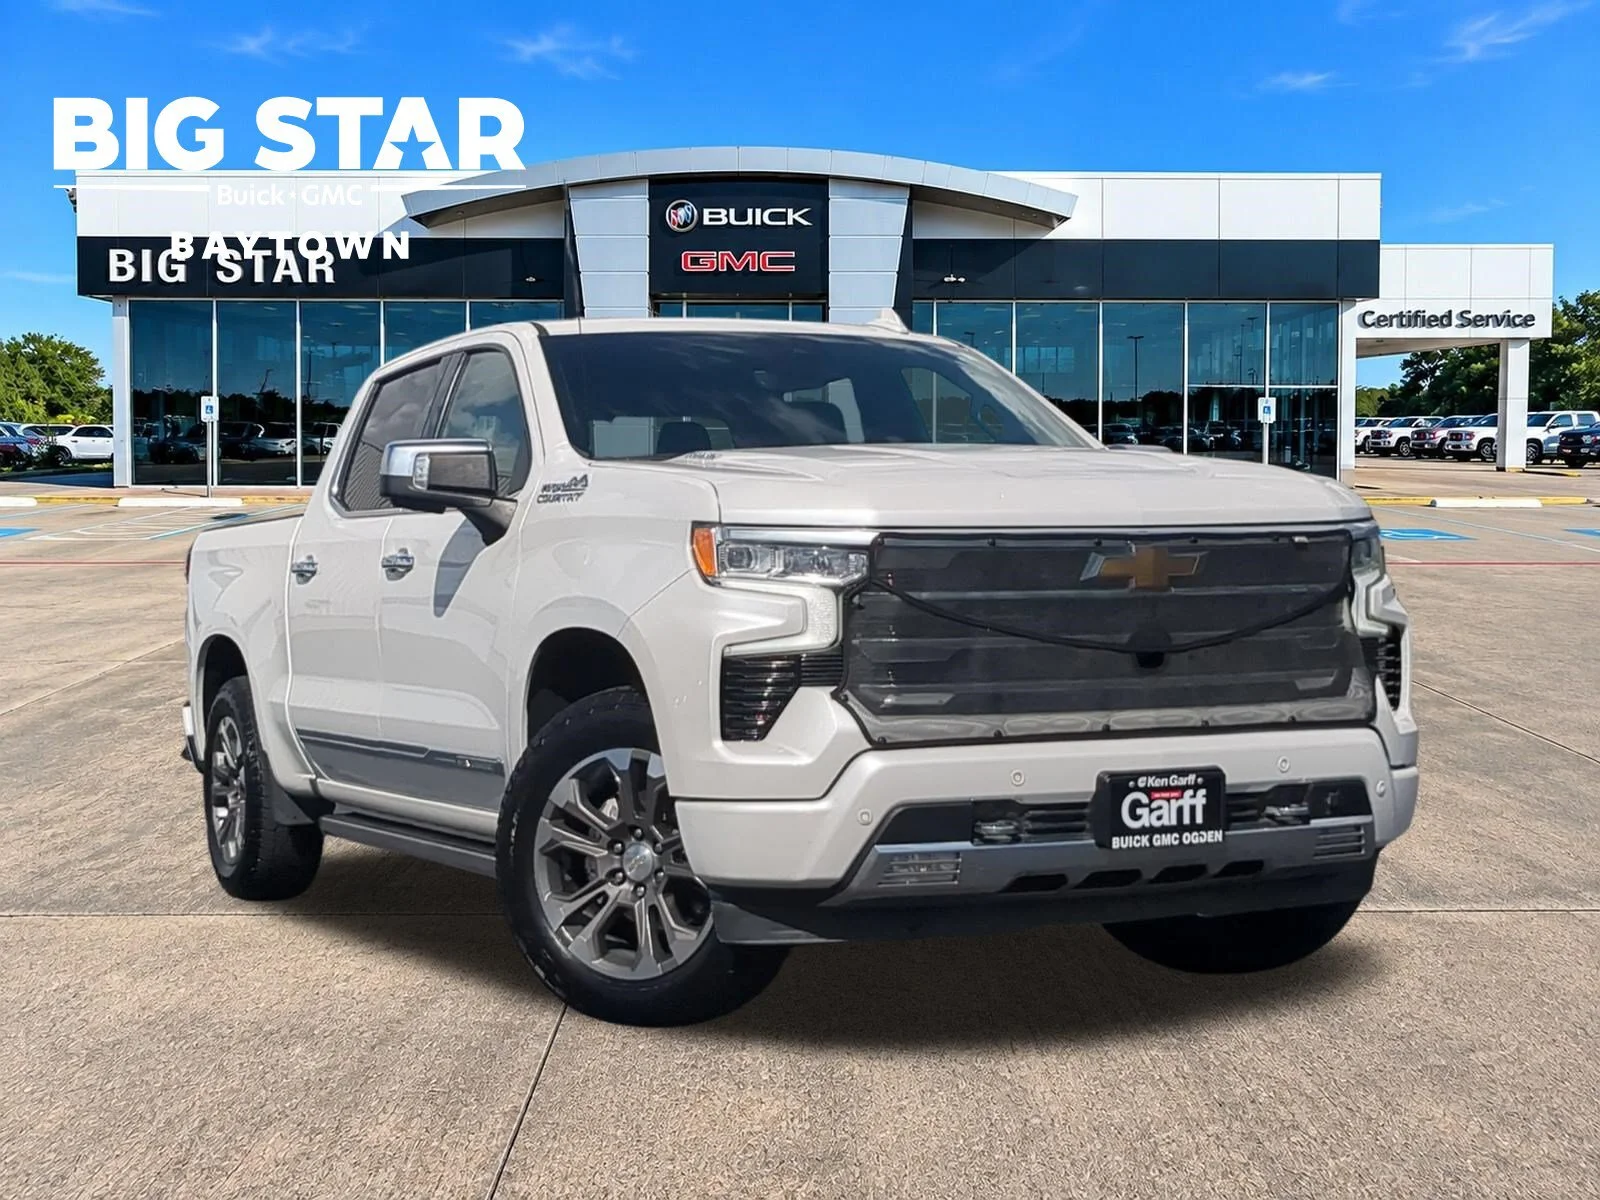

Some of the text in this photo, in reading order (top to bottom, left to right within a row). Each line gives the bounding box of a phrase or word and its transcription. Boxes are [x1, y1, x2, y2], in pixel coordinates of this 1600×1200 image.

[702, 207, 813, 226] BUICK
[108, 248, 336, 284] BIG STAR
[681, 250, 795, 272] GMC
[1360, 309, 1536, 328] Certified Service
[1147, 773, 1196, 787] Ken Garff
[1121, 788, 1207, 829] Garff
[1111, 829, 1223, 849] BUICK GMC OGDEN
